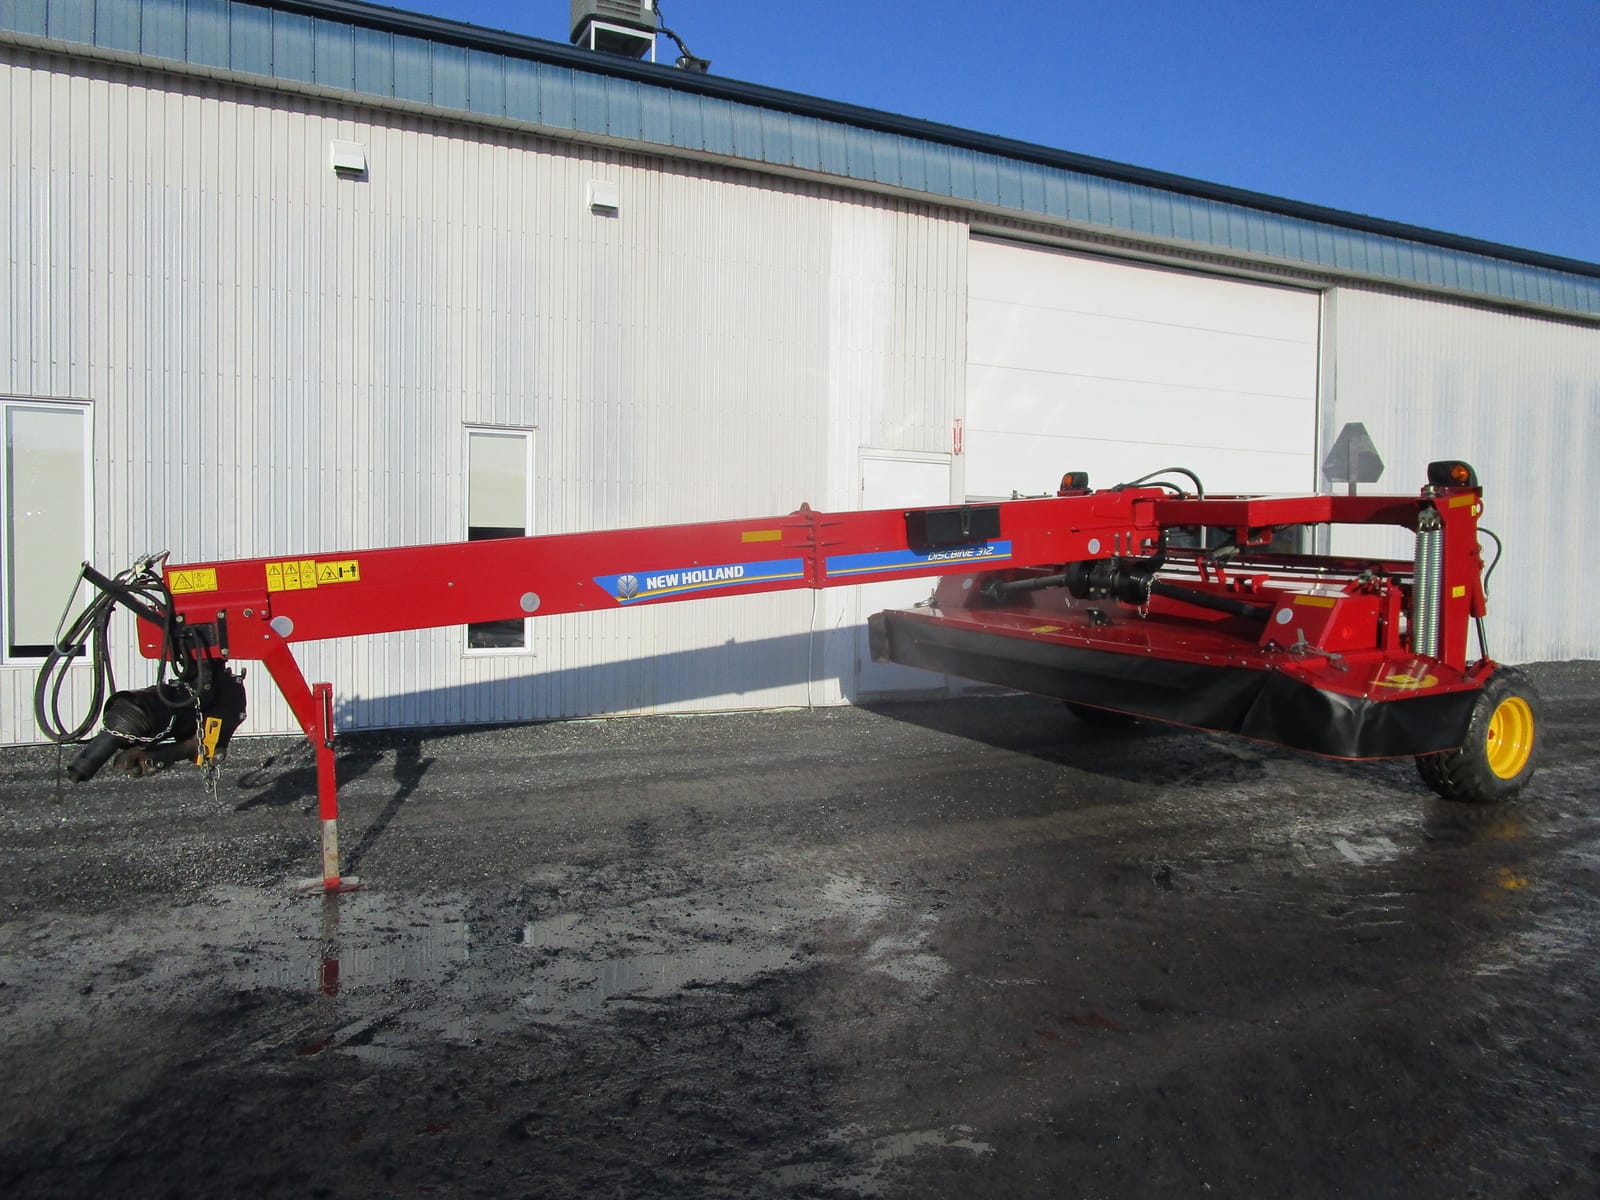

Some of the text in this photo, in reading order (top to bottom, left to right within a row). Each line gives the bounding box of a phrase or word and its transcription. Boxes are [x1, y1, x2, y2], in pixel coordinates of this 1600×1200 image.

[927, 546, 995, 560] DISCBINE 312
[646, 565, 744, 590] NEW HOLLAND
